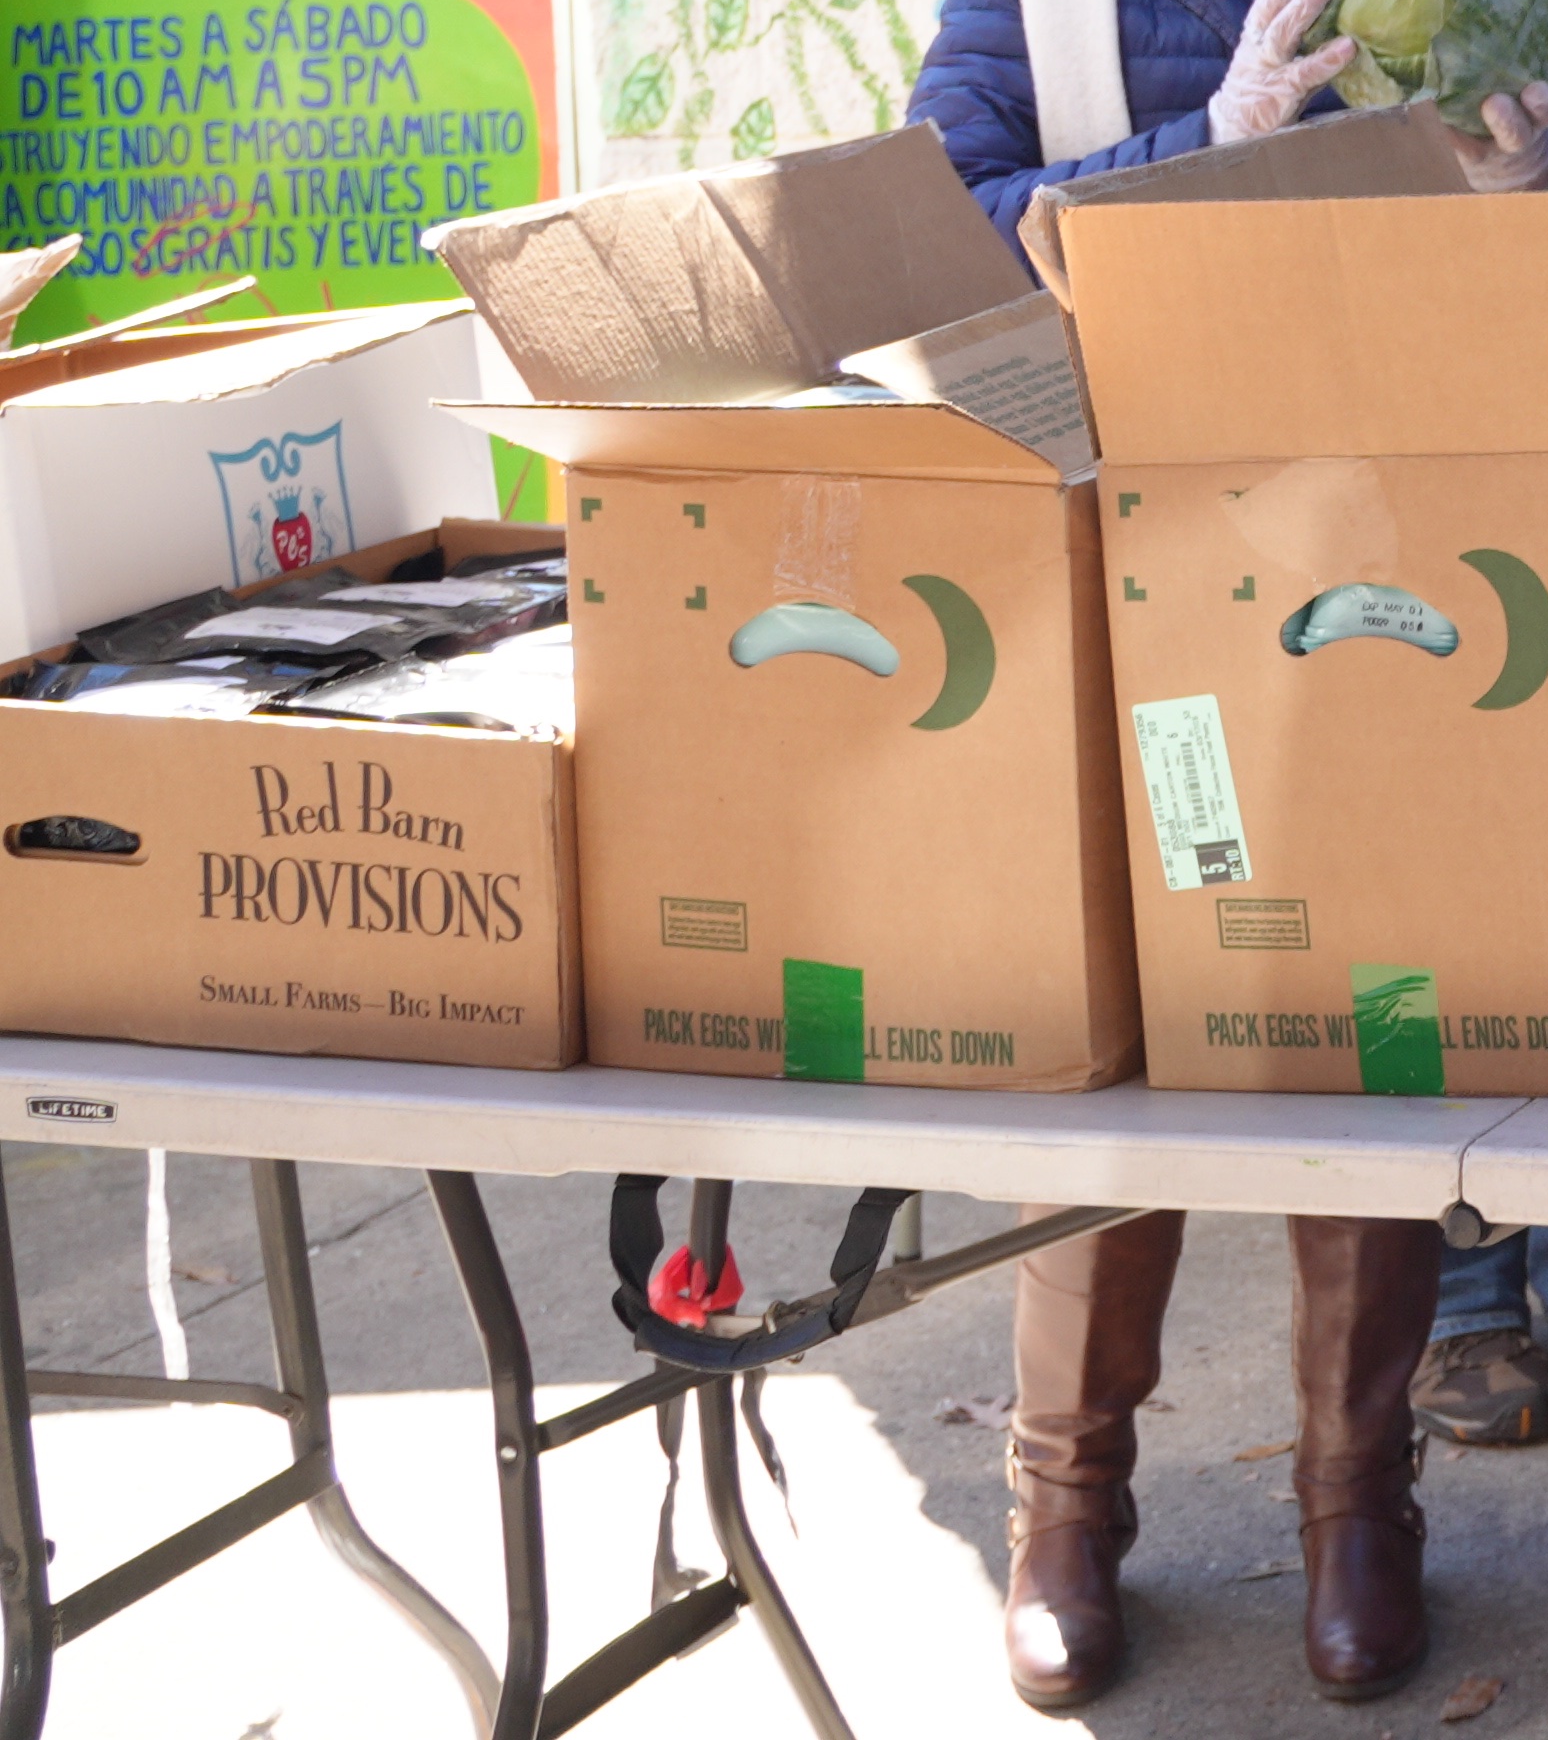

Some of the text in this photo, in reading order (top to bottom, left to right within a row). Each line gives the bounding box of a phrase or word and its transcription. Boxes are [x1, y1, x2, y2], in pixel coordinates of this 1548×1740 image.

[11, 15, 184, 65] MARTES
[203, 13, 228, 55] A
[253, 64, 284, 111] A
[300, 54, 421, 109] 5PM
[0, 110, 525, 176] TRUYENDO EMPODERAMIENTO
[35, 172, 238, 226] COMUNIDAD
[443, 163, 493, 212] DE
[249, 761, 467, 853] Red Barn
[1201, 862, 1227, 875] 5
[196, 850, 524, 946] PROVISIONS
[199, 974, 278, 1009] SMALL
[438, 991, 526, 1027] IMPACT
[643, 1007, 696, 1047] PACK
[700, 1011, 750, 1052] EGGS
[887, 1030, 943, 1066] ENDS
[950, 1030, 1016, 1068] DOWN
[1205, 1012, 1261, 1049] PACK
[1266, 1013, 1319, 1050] EGGS
[1462, 1014, 1521, 1051] ENDS
[38, 1102, 107, 1118] LIFETIME
